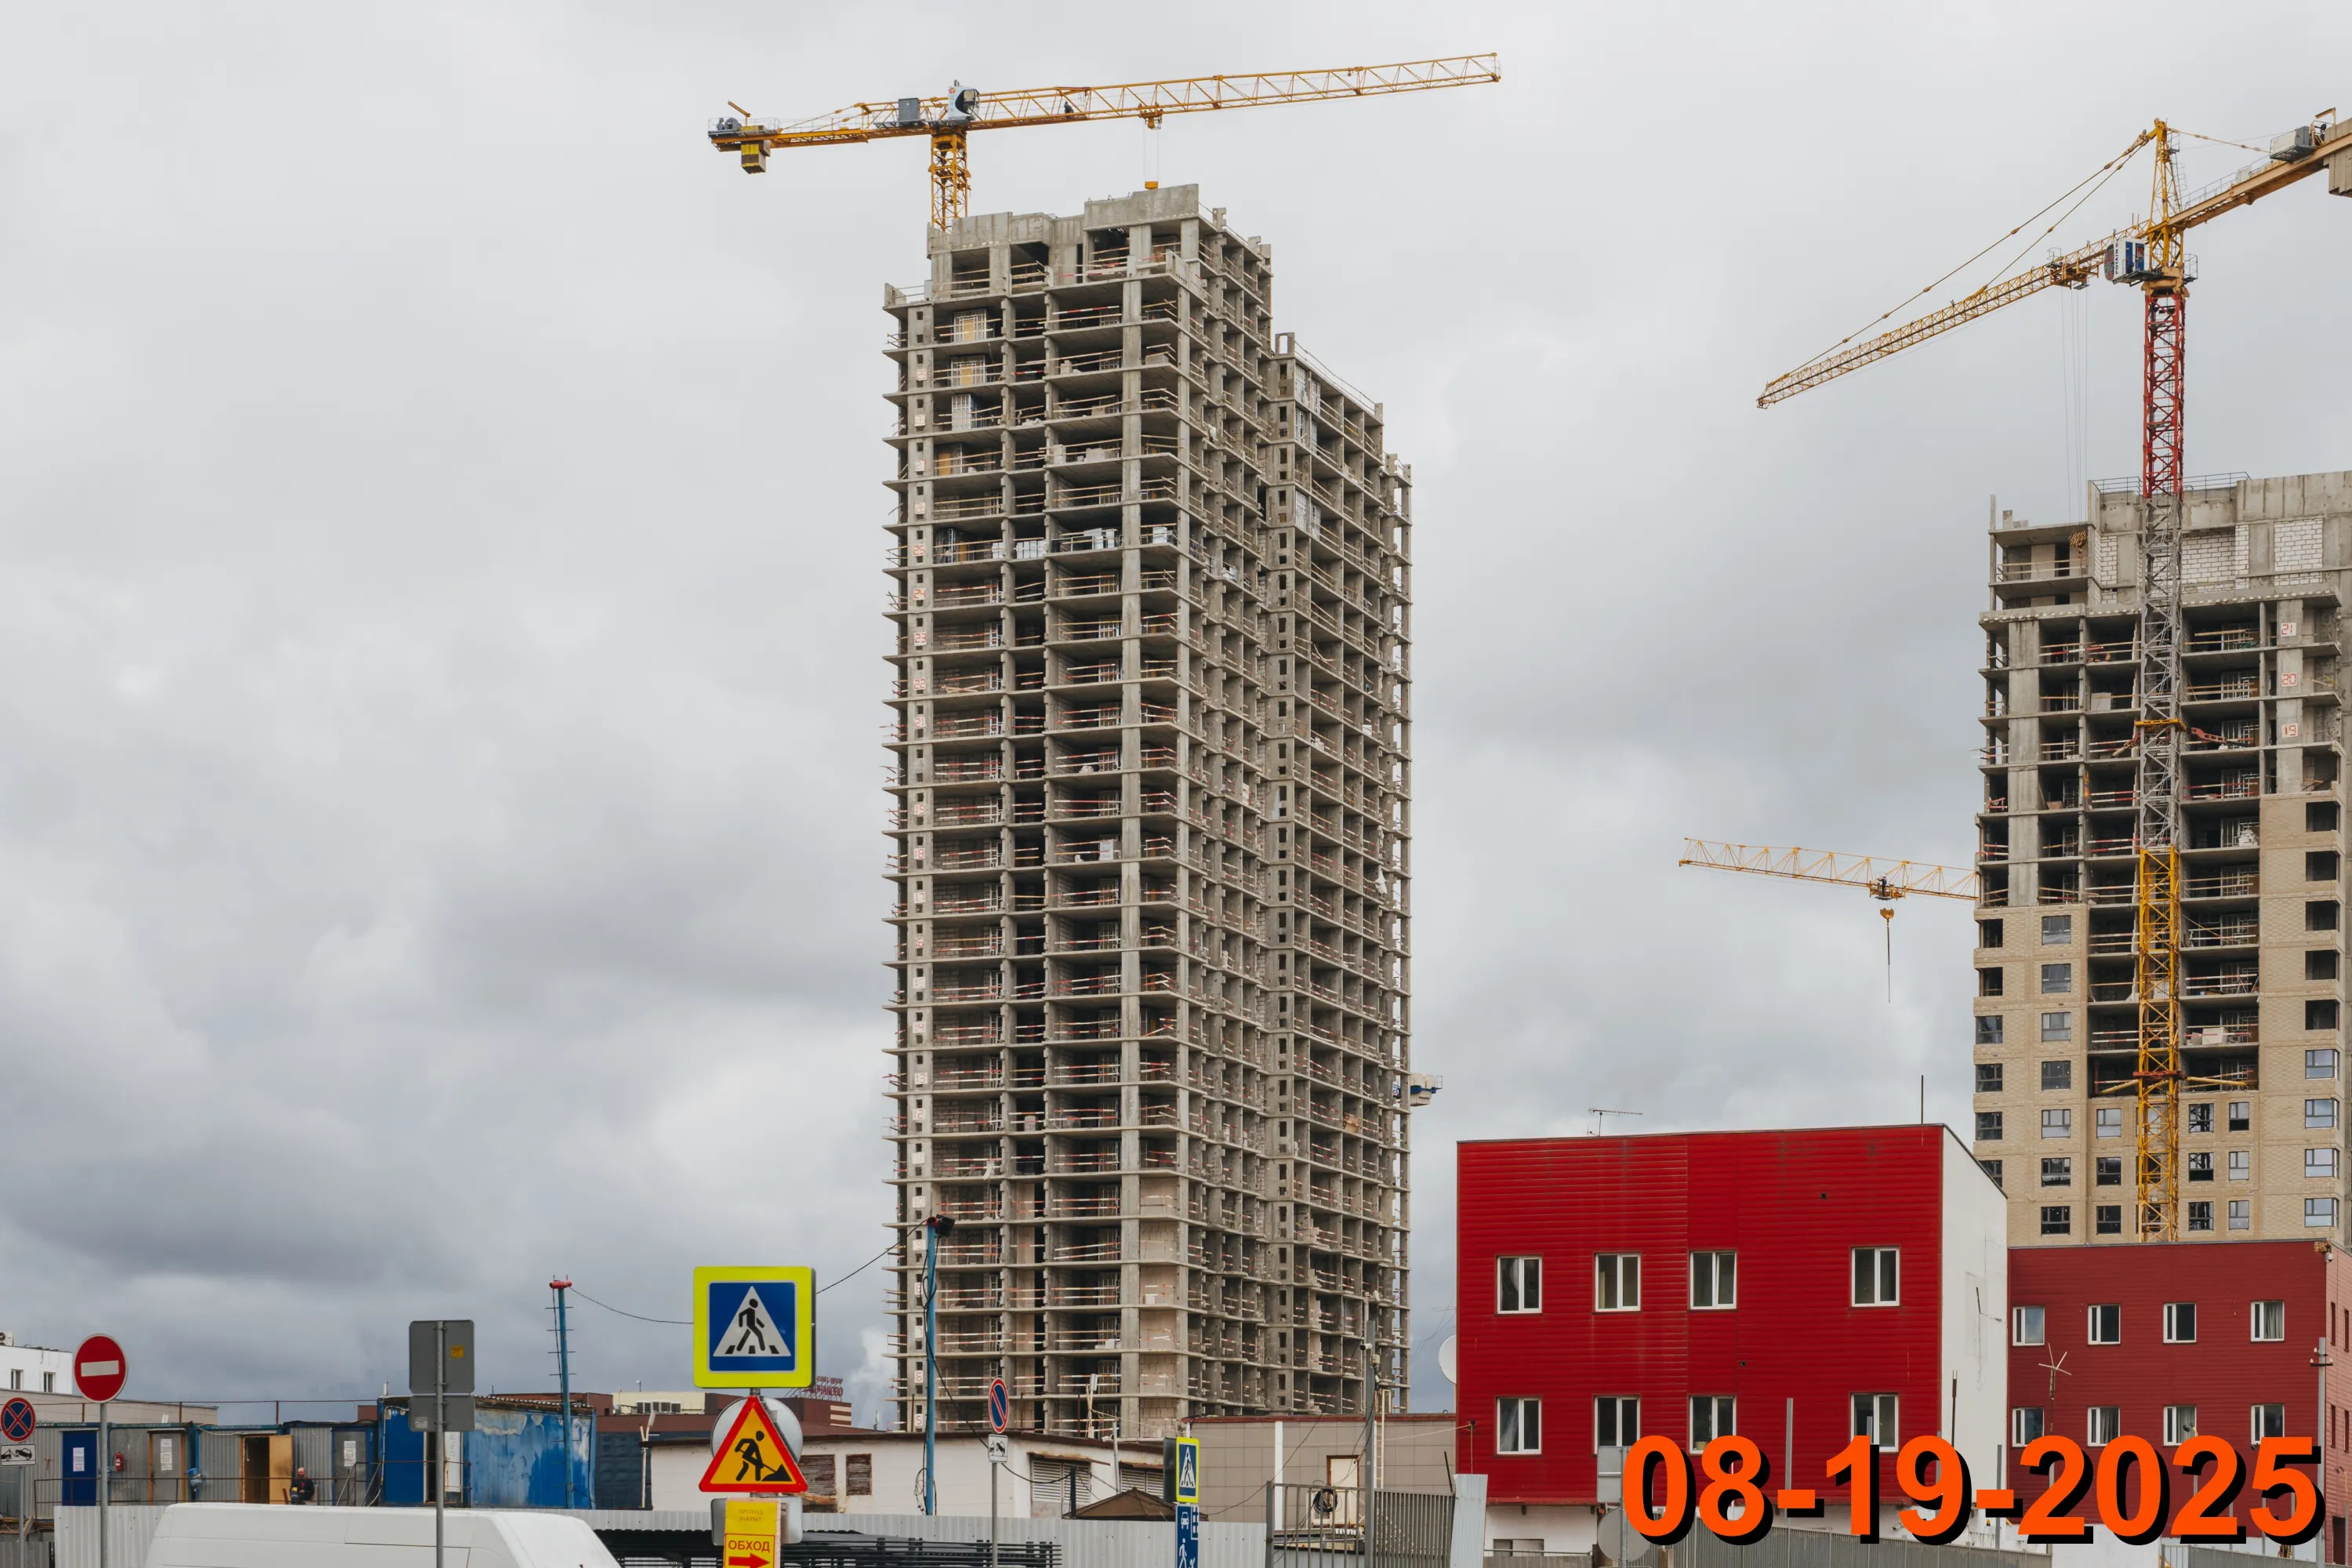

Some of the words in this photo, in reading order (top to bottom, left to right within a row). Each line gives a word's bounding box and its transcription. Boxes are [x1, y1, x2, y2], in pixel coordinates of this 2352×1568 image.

[913, 545, 925, 556] 25
[913, 588, 926, 599] 24
[2281, 624, 2293, 636] 21
[914, 633, 927, 644] 23
[914, 678, 926, 690] 22
[2281, 673, 2296, 685] 20
[915, 717, 924, 728] 21
[2284, 724, 2296, 736] 19
[916, 848, 924, 858] 18
[915, 938, 924, 948] 16
[916, 1371, 923, 1382] 6
[916, 1415, 923, 1425] 5
[728, 1540, 770, 1552] ОБХОД
